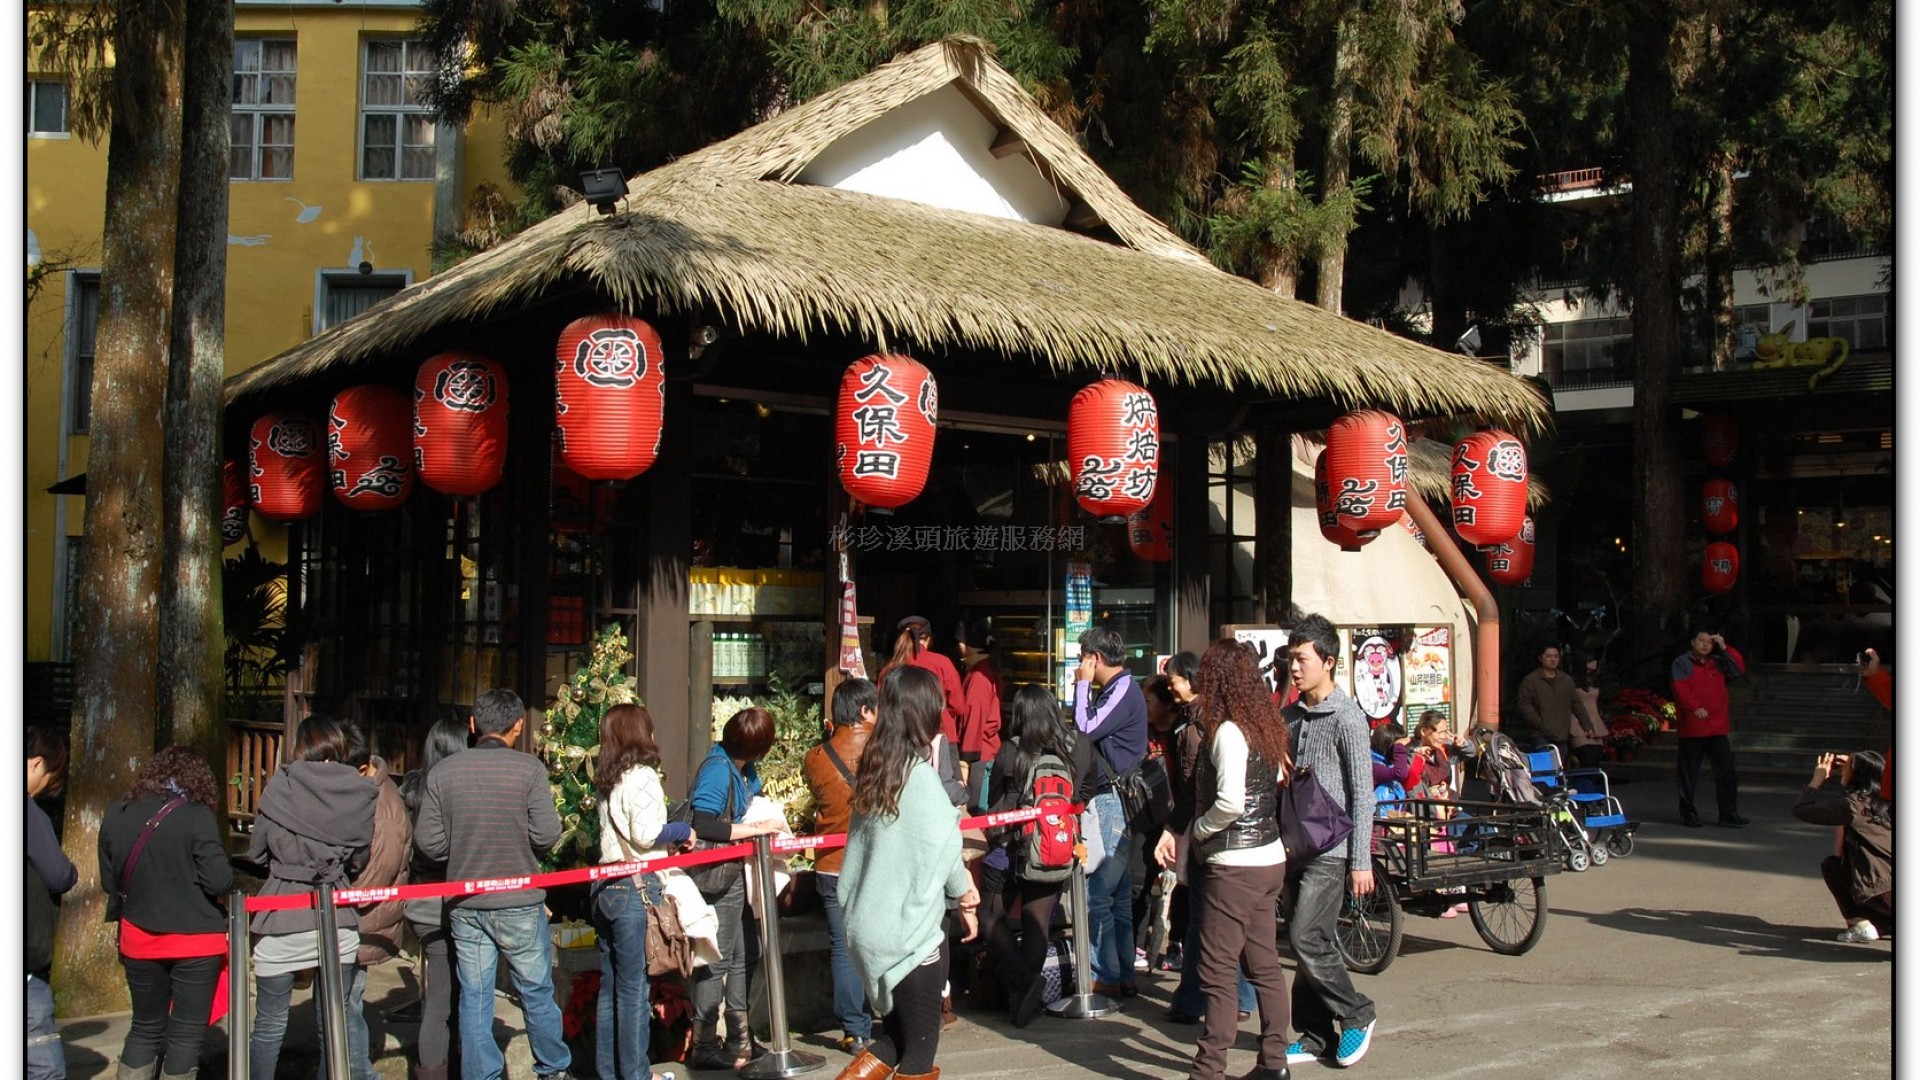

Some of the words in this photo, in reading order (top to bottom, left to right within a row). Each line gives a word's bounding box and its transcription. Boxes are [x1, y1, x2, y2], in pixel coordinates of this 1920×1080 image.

[852, 364, 909, 479] 久保田
[1121, 392, 1159, 501] 烘焙坊
